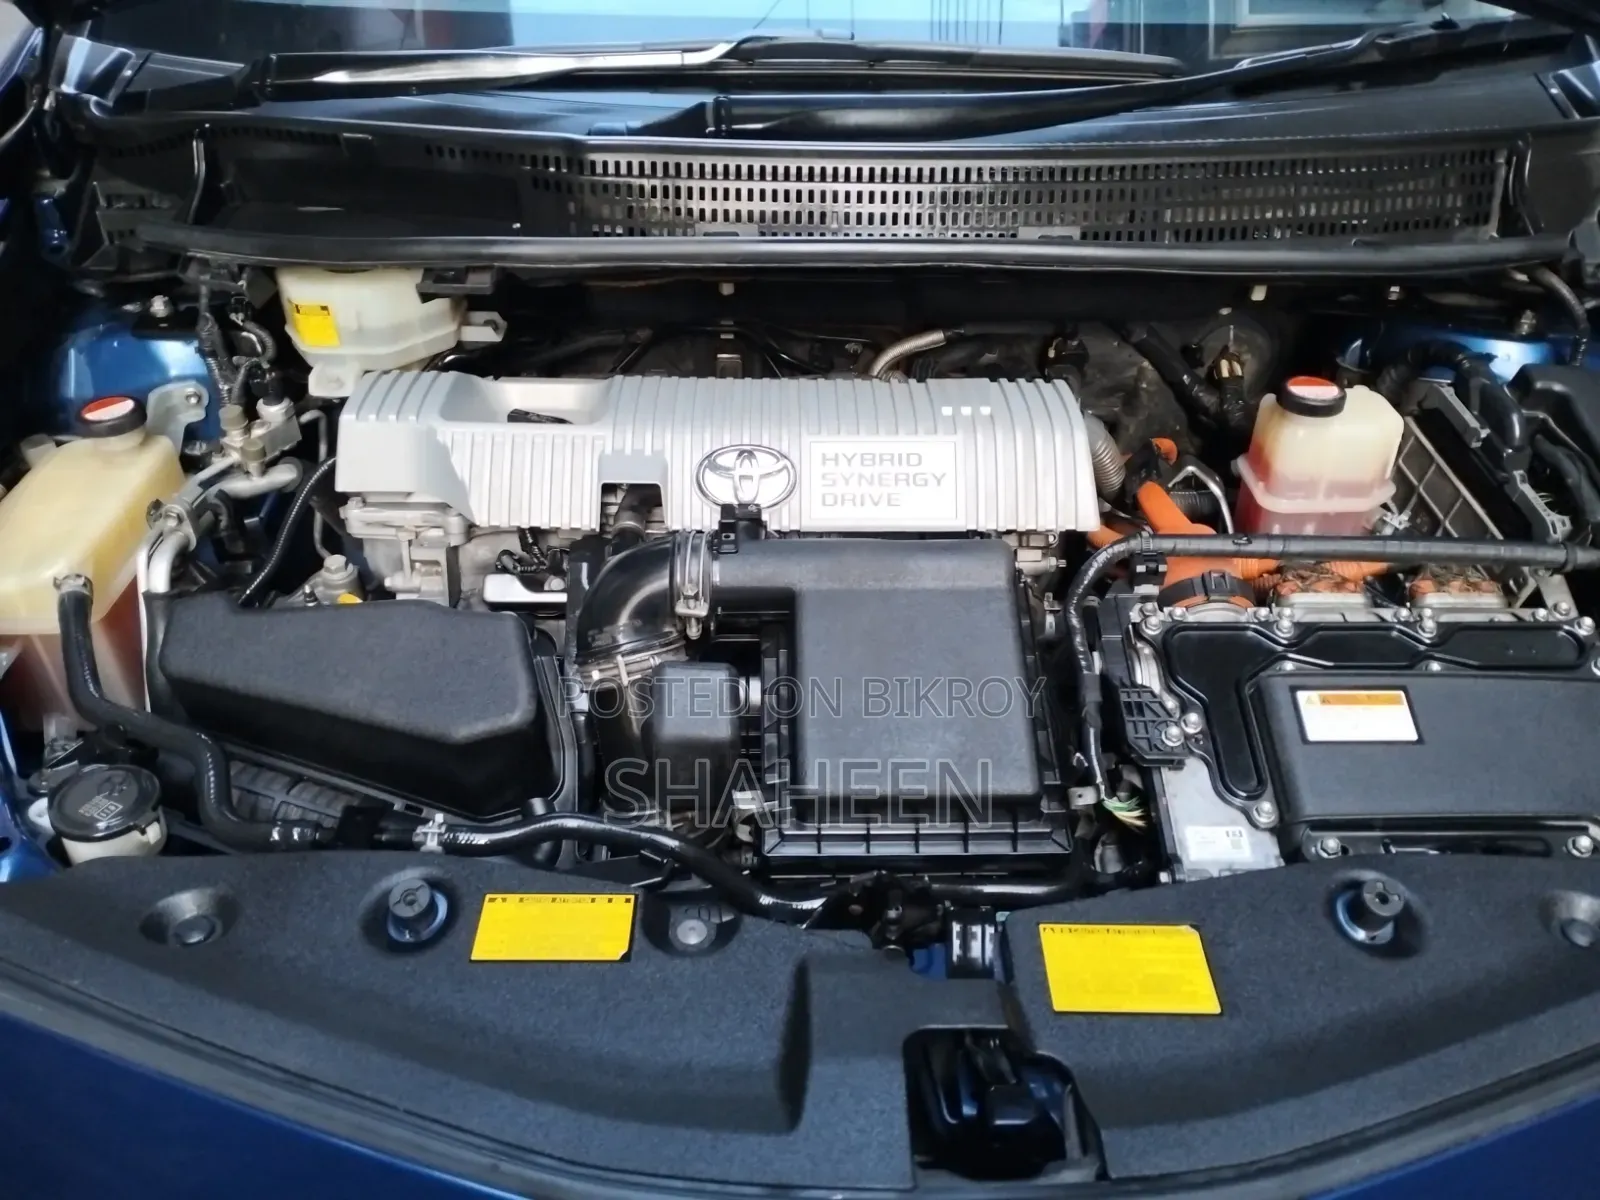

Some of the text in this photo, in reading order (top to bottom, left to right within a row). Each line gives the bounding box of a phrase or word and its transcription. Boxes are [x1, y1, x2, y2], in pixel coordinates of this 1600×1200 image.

[821, 452, 923, 467] HYBRID
[821, 472, 947, 487] SYNERGY
[821, 493, 901, 507] DRIVE
